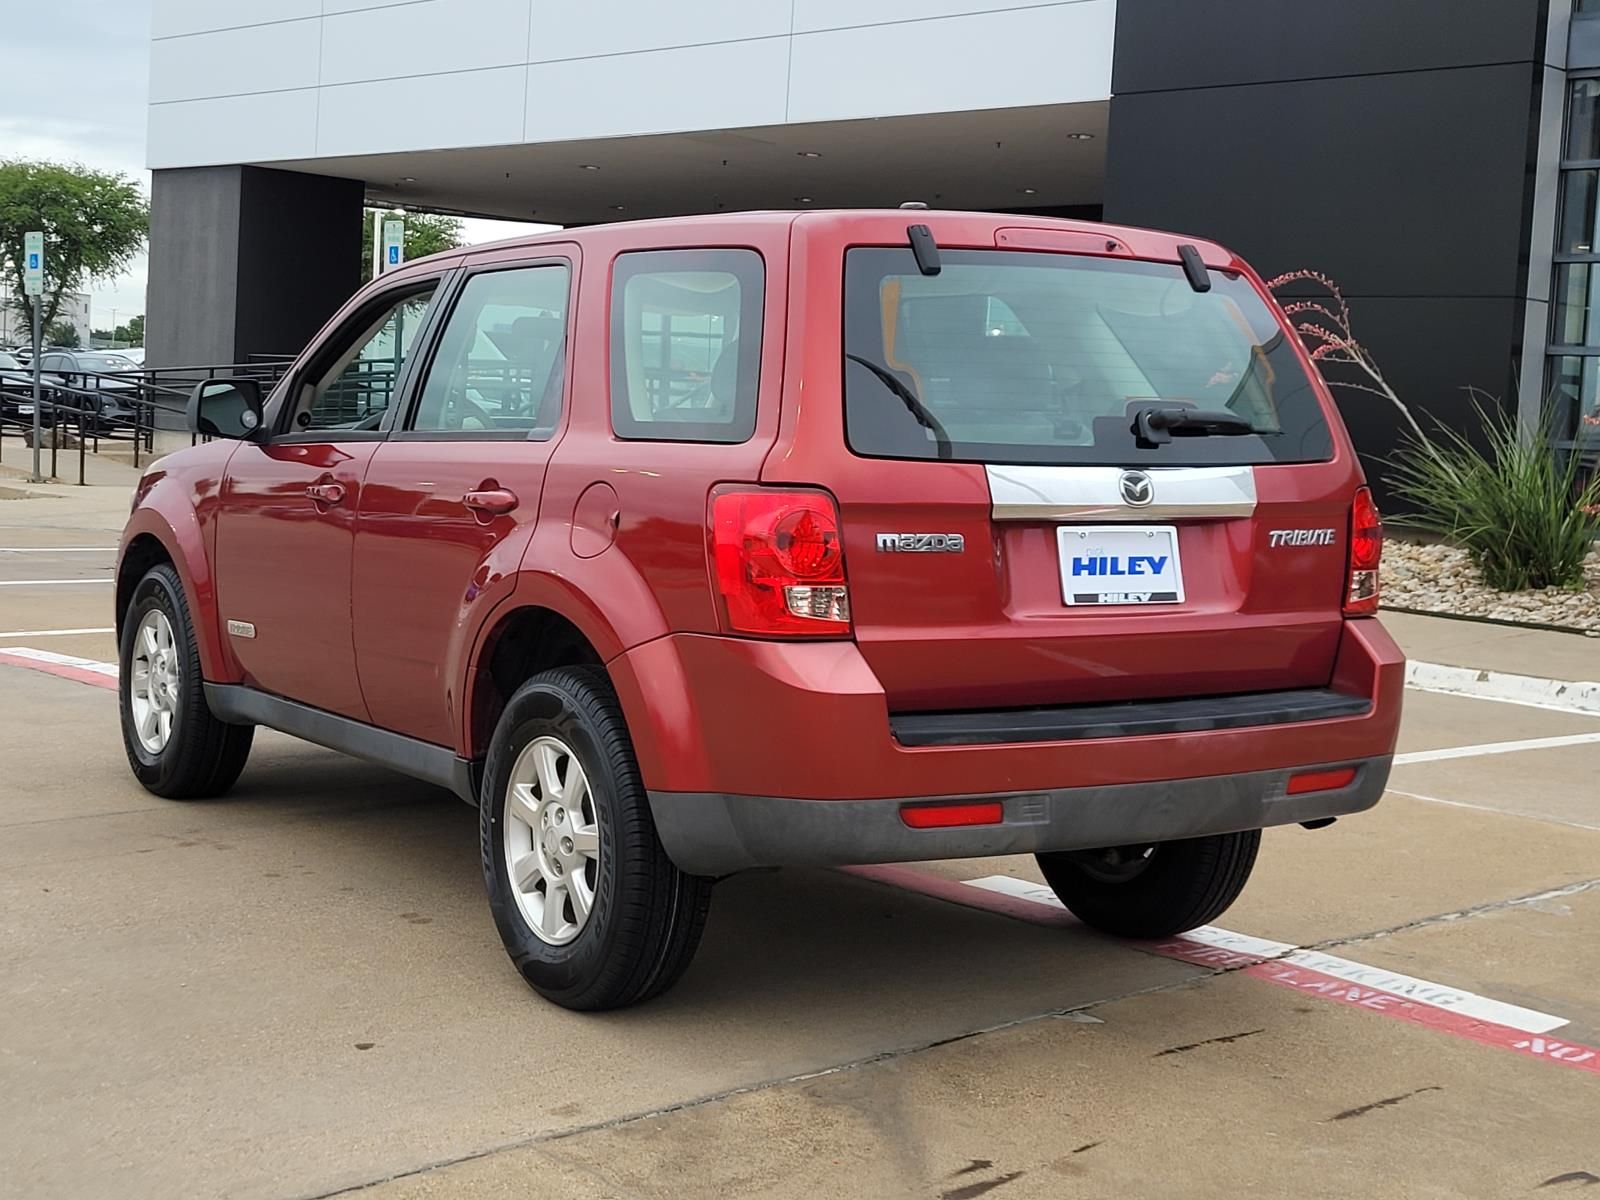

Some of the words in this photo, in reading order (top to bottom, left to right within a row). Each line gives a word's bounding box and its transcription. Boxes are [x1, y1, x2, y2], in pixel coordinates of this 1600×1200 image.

[1269, 528, 1336, 548] TRIBUTE
[1072, 556, 1168, 576] HILEY
[1098, 592, 1153, 604] HILEY
[1271, 970, 1407, 1010] LANE
